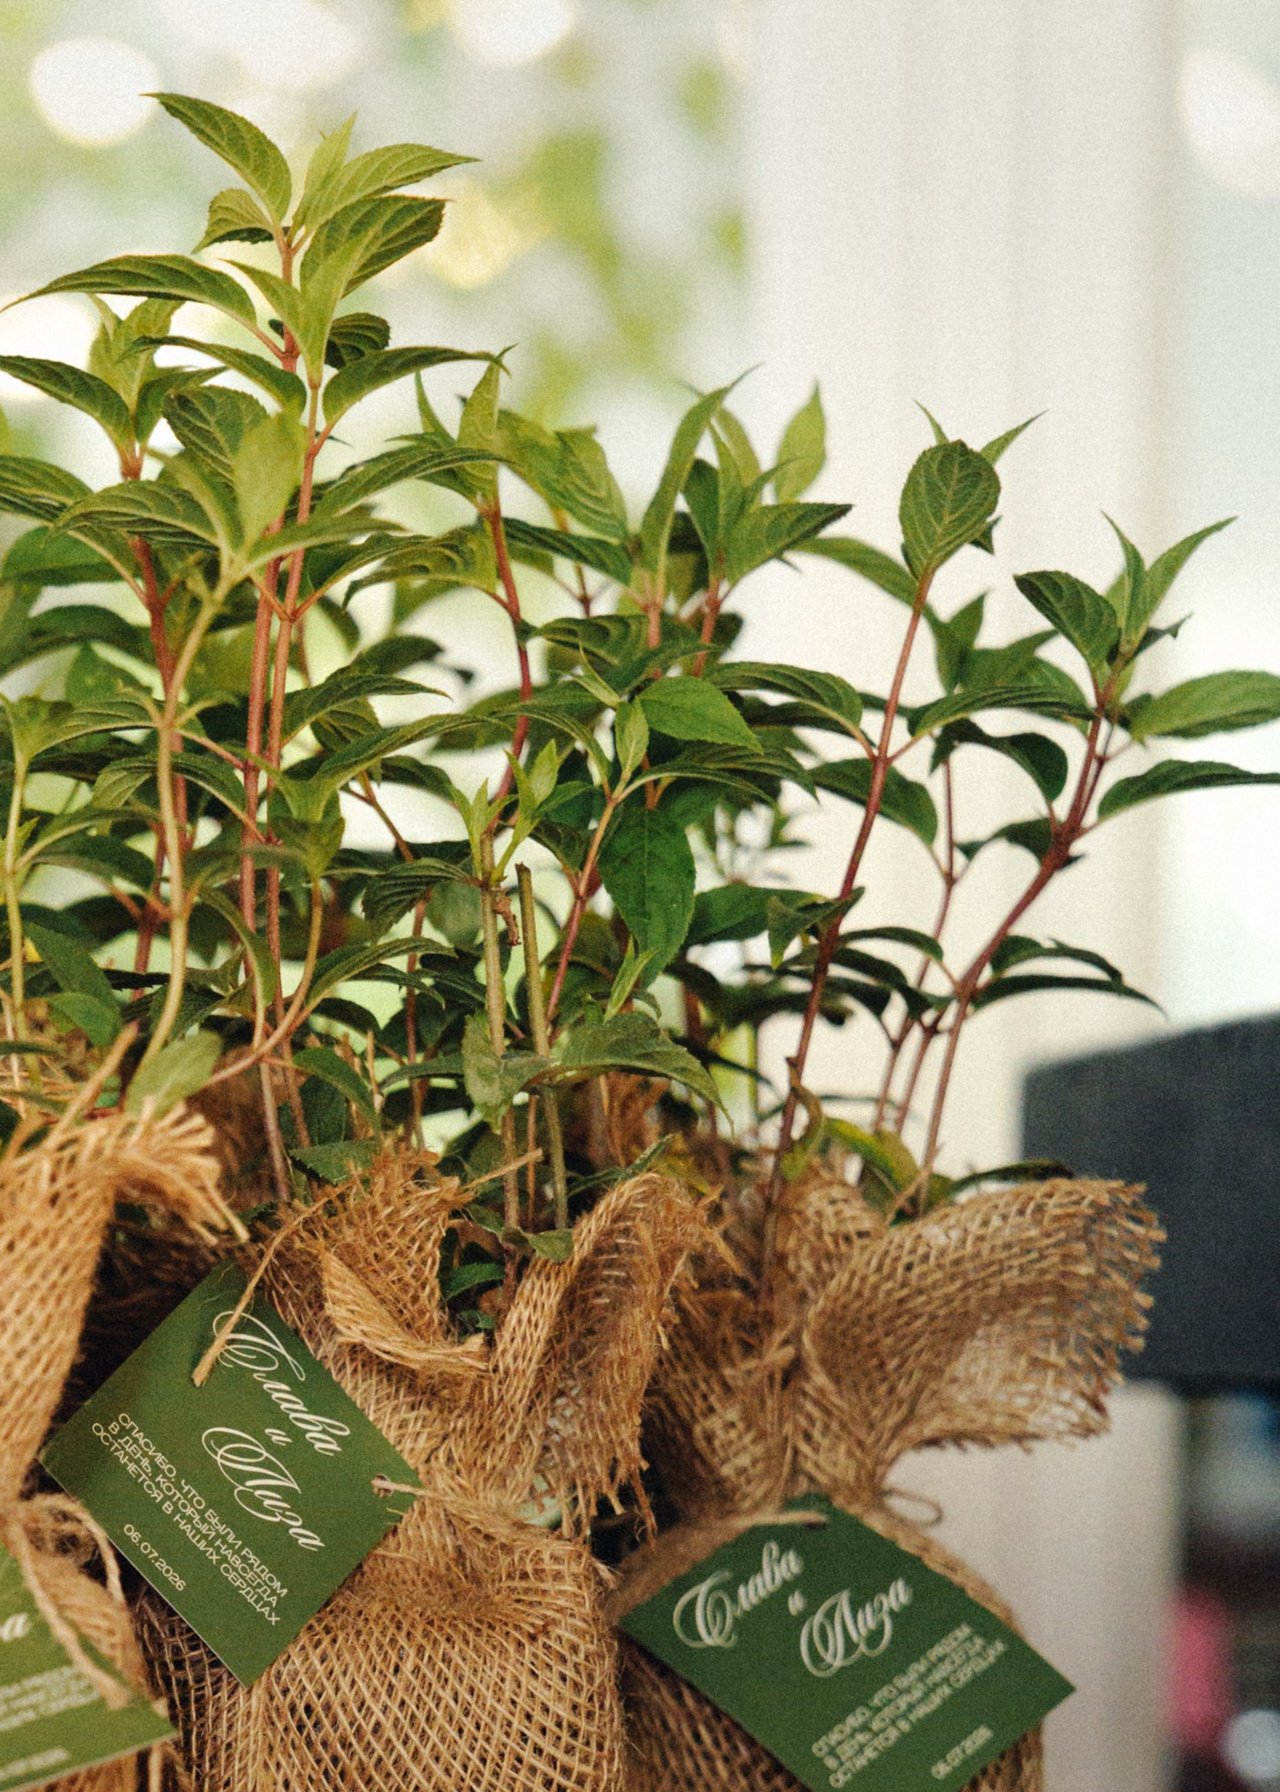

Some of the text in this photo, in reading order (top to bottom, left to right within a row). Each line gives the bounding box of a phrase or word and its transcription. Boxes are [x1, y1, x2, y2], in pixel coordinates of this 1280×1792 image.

[213, 1311, 351, 1456] Слава
[265, 1428, 293, 1446] и
[92, 1422, 281, 1626] ОСТАНЕТСЯ В НАШИХ СЕРДЦАХ
[108, 1421, 278, 1607] В ДЕНЬ, КОТОРЫЙ НАВСЕГДА
[118, 1413, 288, 1598] СПАСИБО, ЧТО БЫЛИ РЯДОМ
[202, 1427, 325, 1552] Лиза
[123, 1524, 186, 1591] 06.07.2026
[672, 1540, 804, 1649] Слава
[800, 1577, 914, 1678] Лиза
